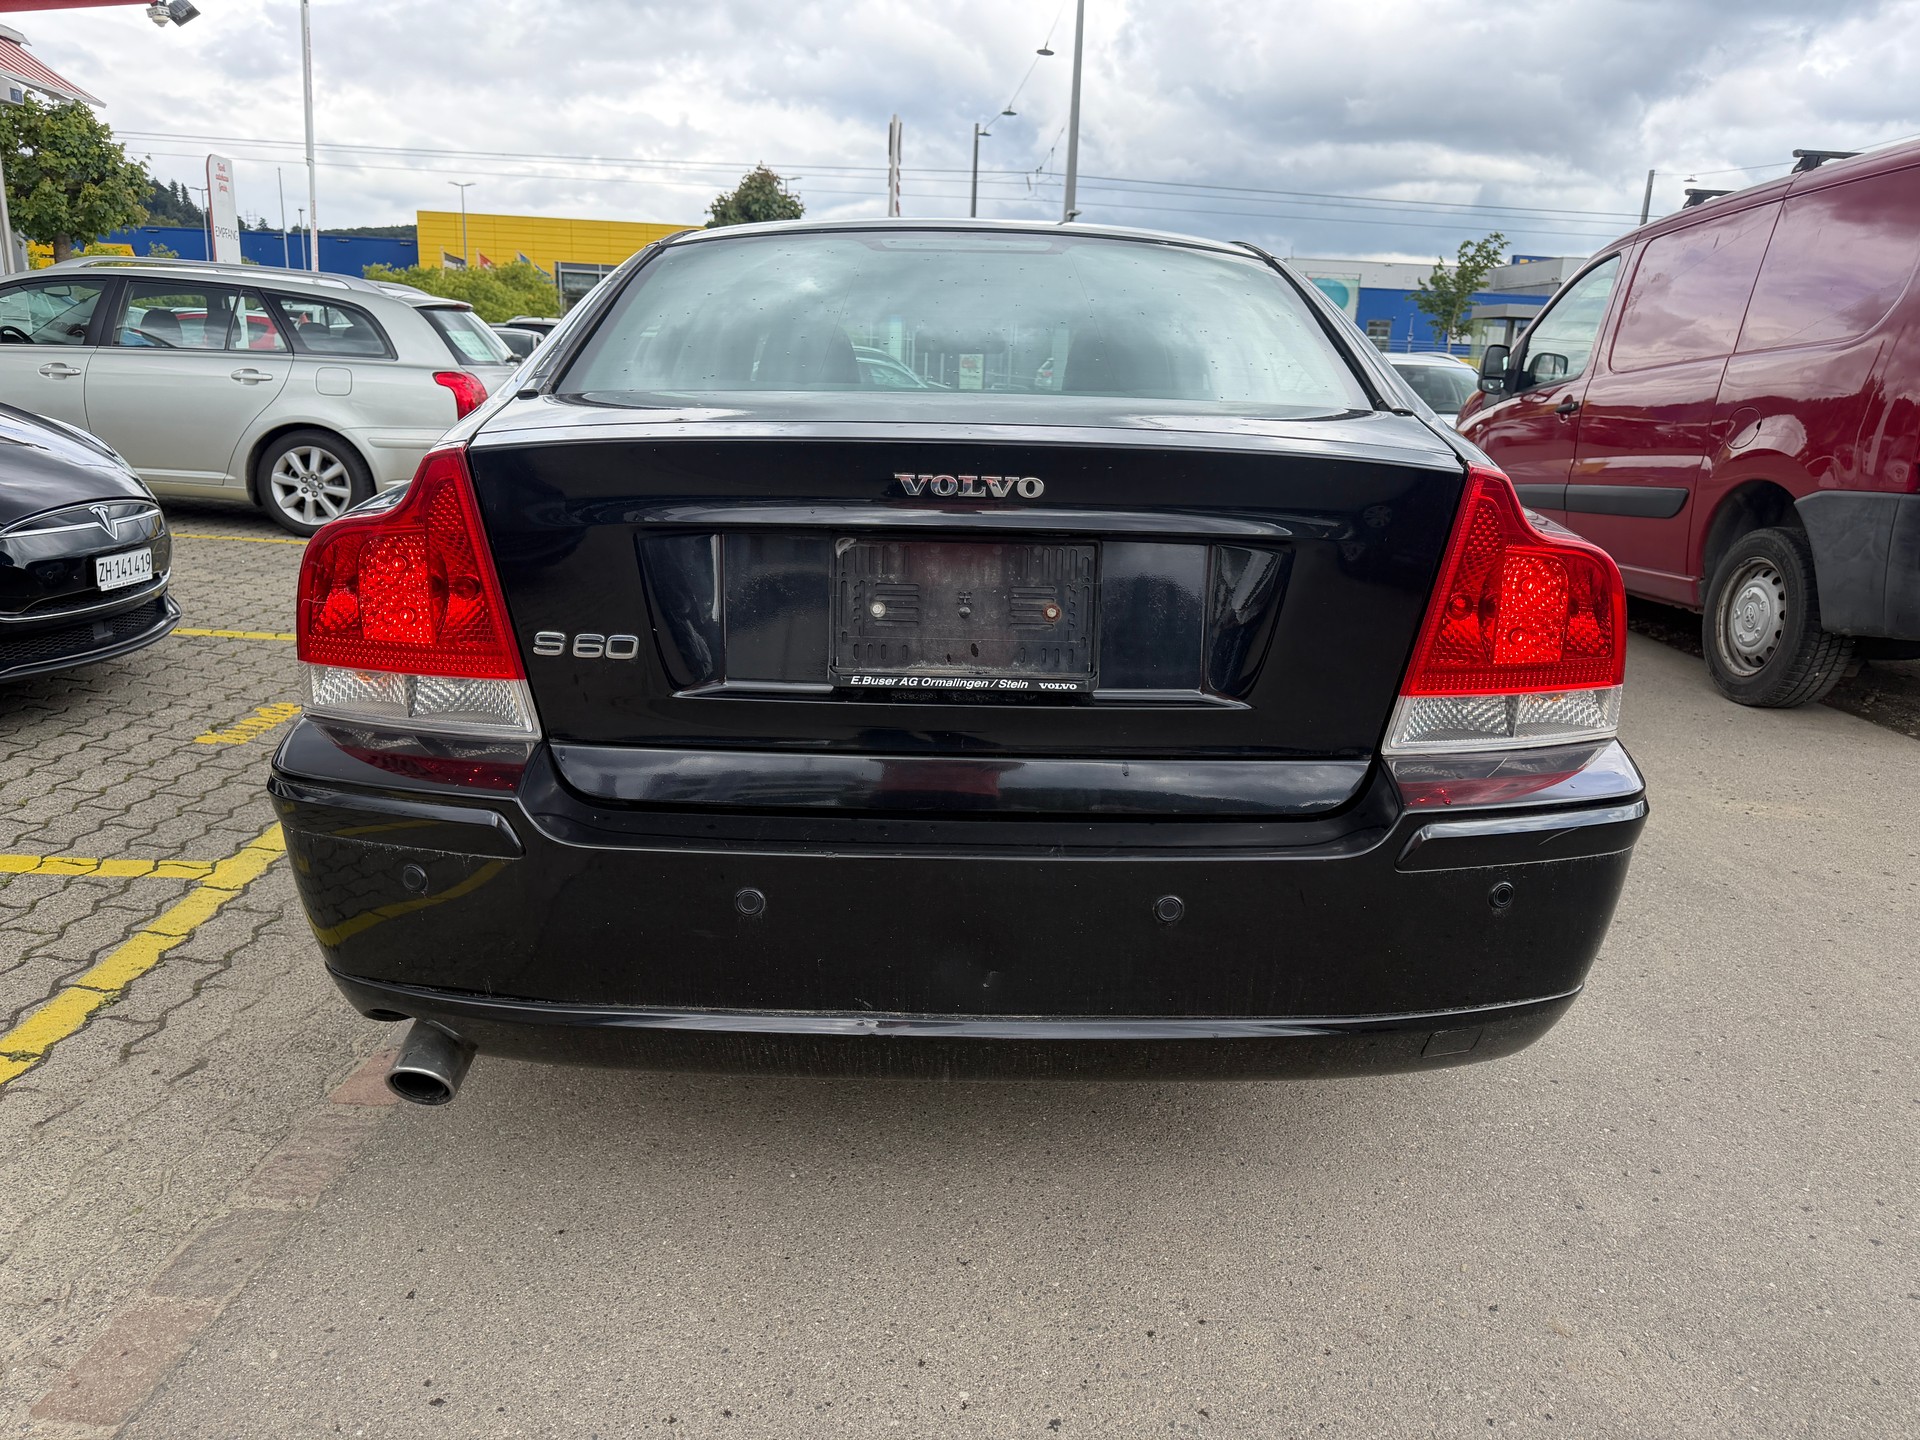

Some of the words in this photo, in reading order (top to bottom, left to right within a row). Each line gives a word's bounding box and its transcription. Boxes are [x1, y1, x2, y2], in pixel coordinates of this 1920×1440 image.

[894, 473, 1045, 499] VOLVO
[850, 675, 898, 686] E.Buser
[899, 677, 918, 686] AG
[921, 677, 989, 690] Ormalingen
[998, 679, 1029, 689] Stein
[1038, 682, 1078, 690] VOLVO
